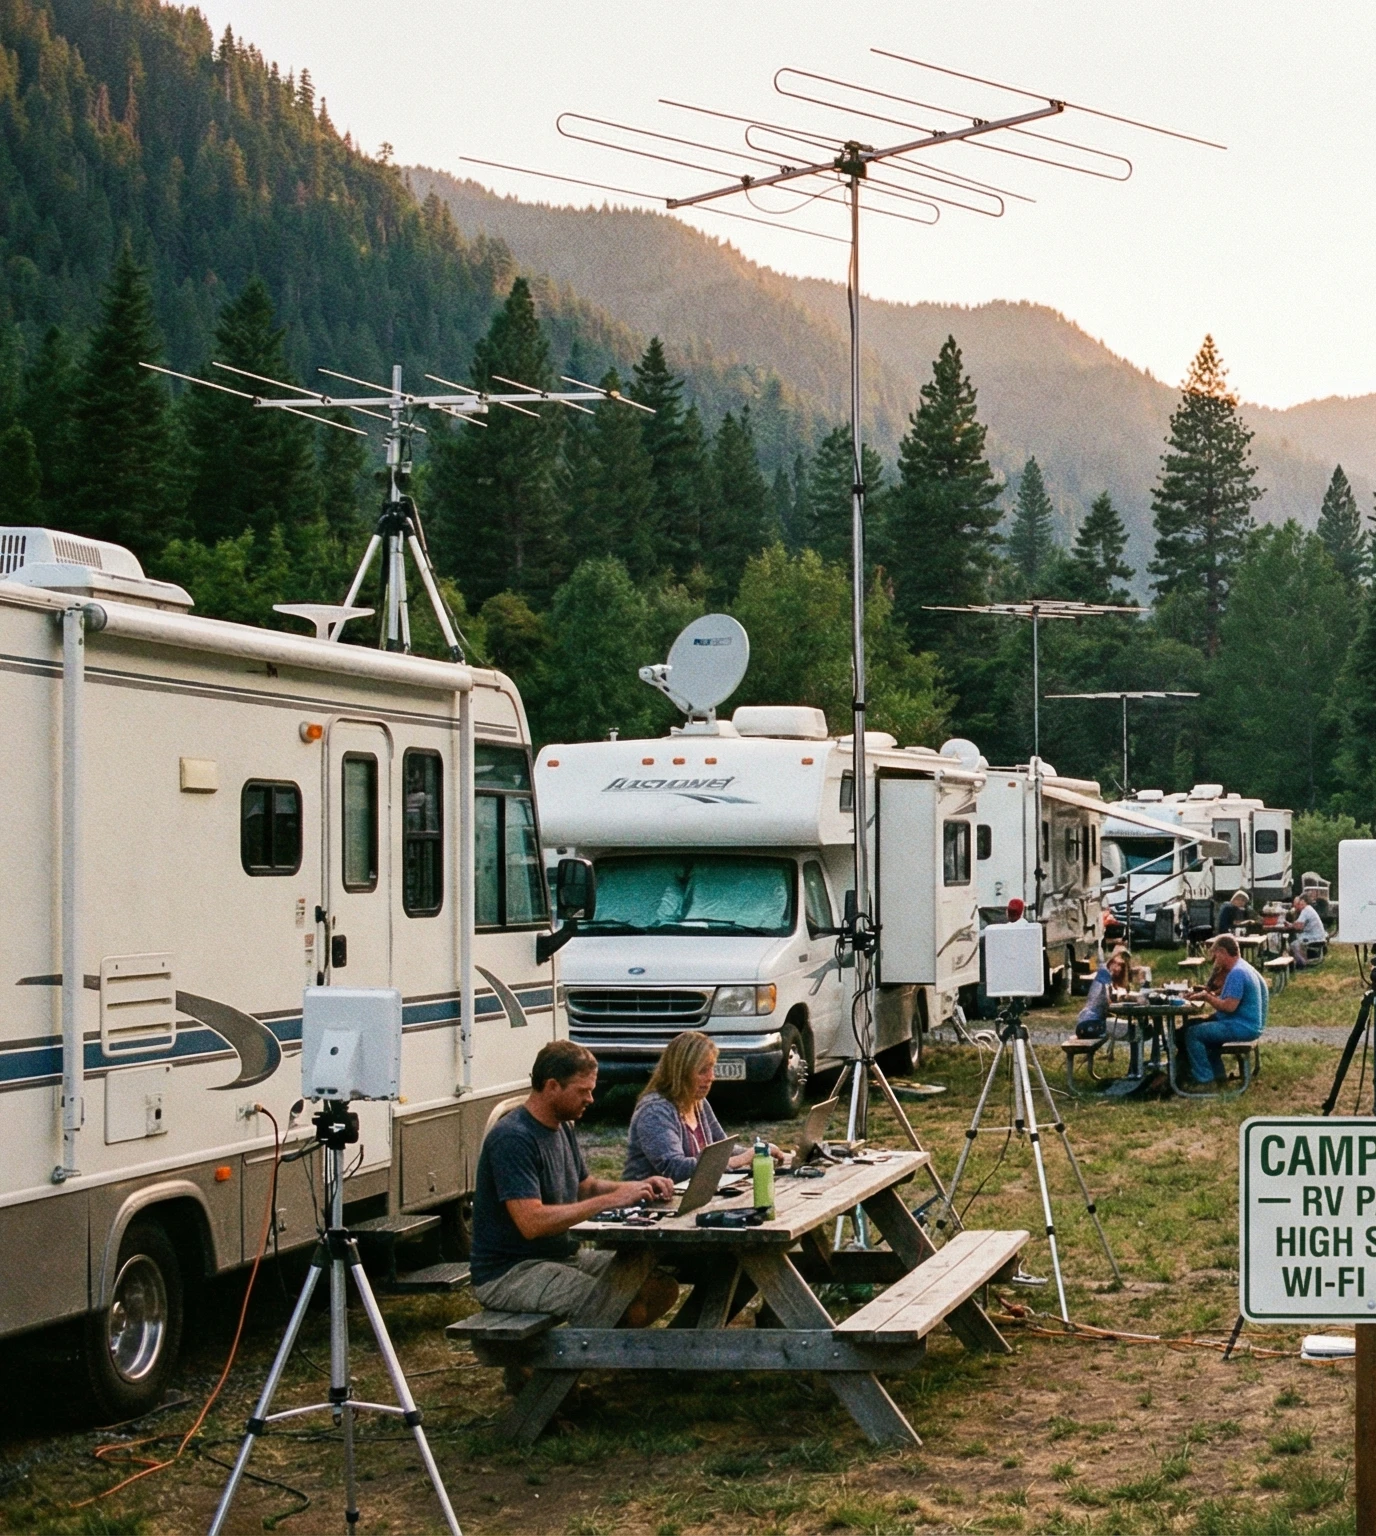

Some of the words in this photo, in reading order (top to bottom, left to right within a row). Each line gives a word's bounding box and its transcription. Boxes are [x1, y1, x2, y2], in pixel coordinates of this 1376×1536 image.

[1302, 1185, 1345, 1217] RV
[1275, 1225, 1353, 1258] HIGH
[1281, 1266, 1365, 1298] WI-FI
